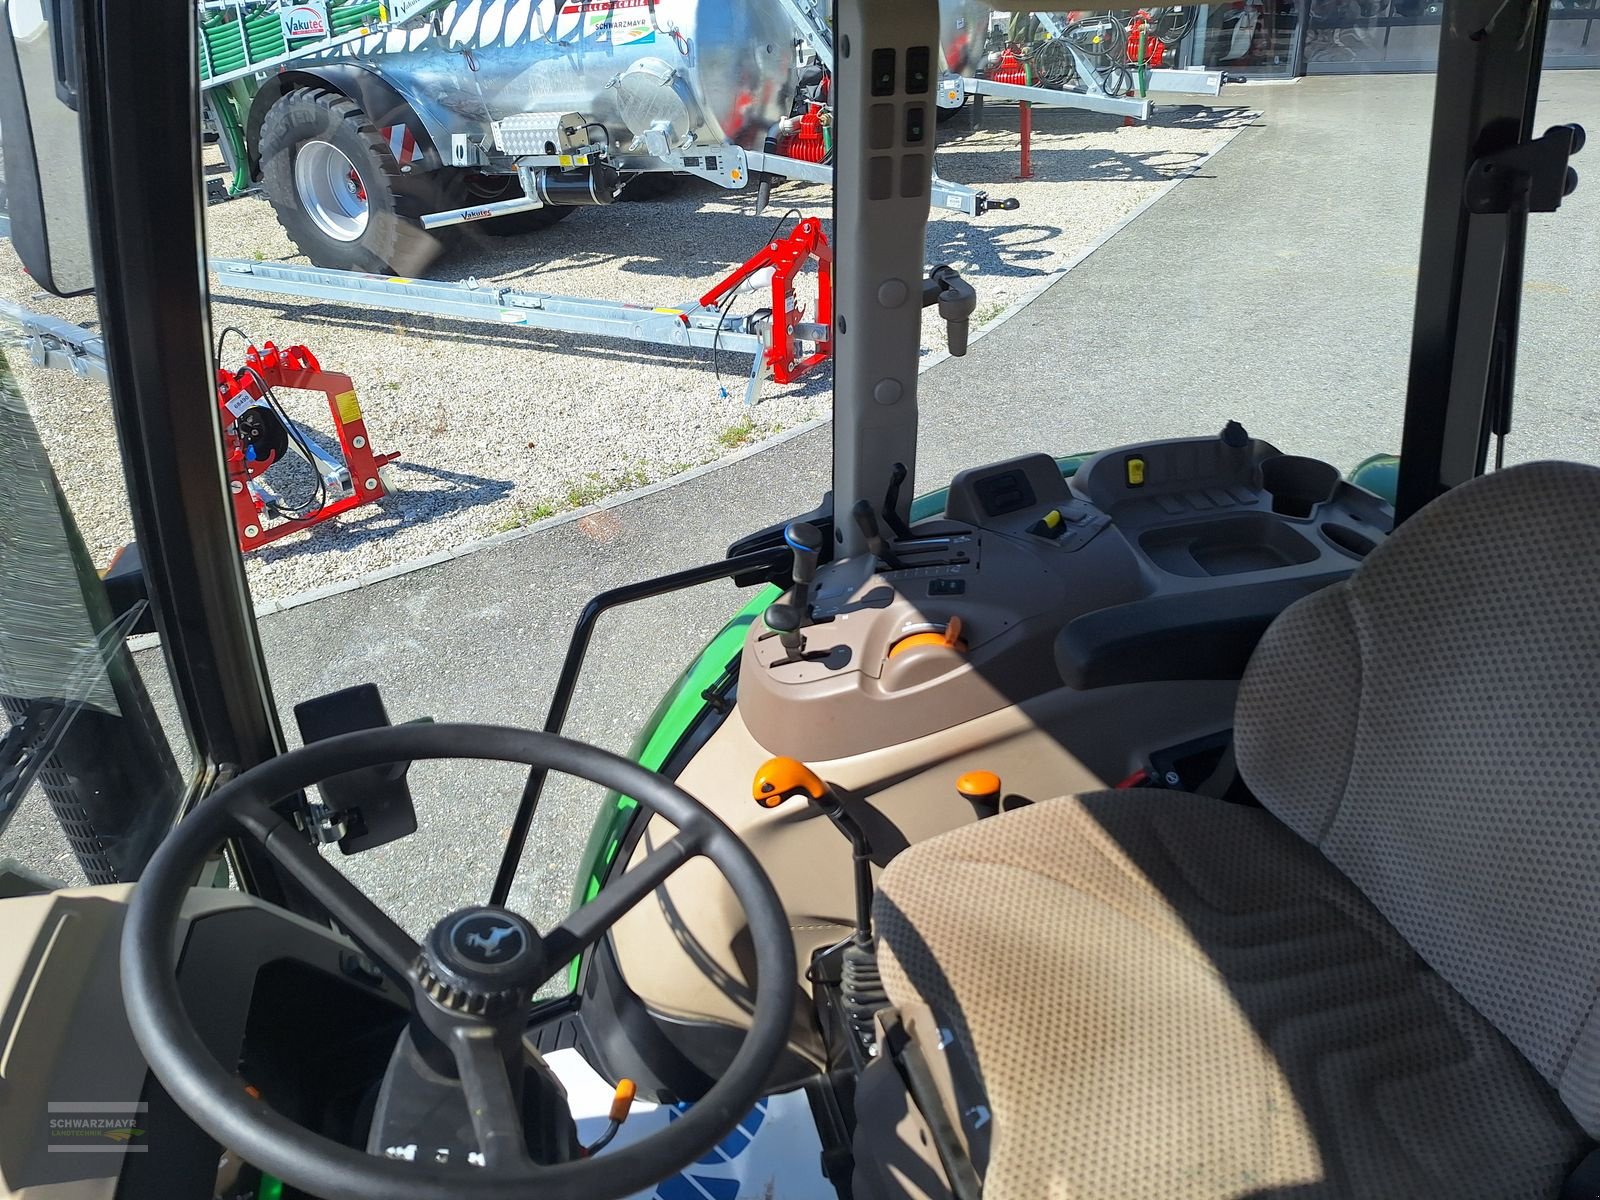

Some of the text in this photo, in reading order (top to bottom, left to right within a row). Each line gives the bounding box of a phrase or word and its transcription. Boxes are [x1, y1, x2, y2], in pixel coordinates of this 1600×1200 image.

[285, 17, 323, 35] Vakutec
[595, 19, 646, 31] SCHWARZMAYR
[461, 210, 492, 220] Vakutec
